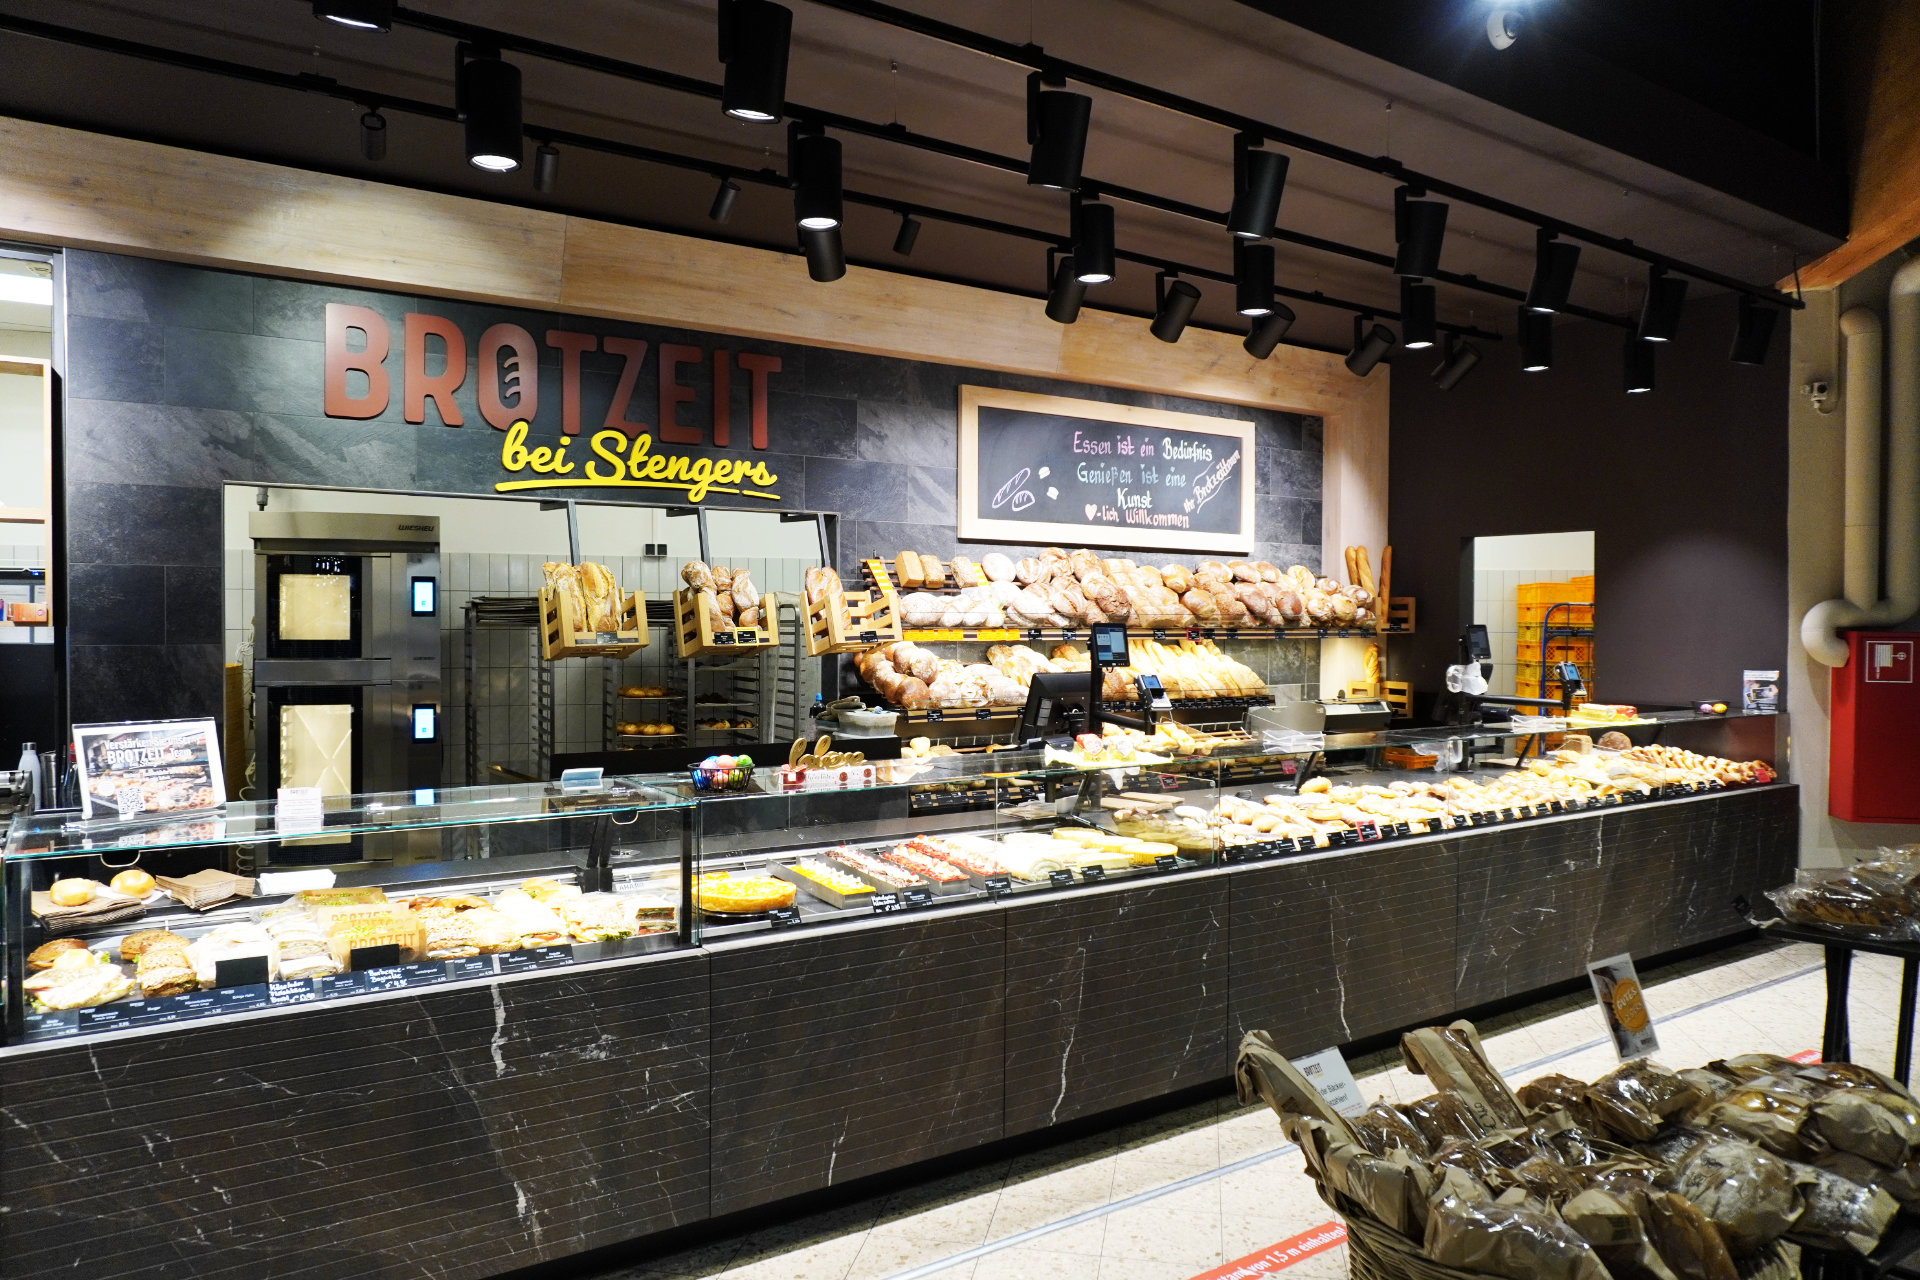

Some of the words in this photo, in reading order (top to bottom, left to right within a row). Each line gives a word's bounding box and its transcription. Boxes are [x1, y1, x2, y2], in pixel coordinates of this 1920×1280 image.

[324, 302, 782, 450] BROTZEIT
[1073, 431, 1111, 455] Essen
[1116, 435, 1135, 456] ist
[1140, 437, 1154, 457] ein
[1162, 437, 1213, 462] Bedürfnis
[501, 421, 575, 474] bei
[585, 430, 778, 503] Stengers
[1077, 462, 1132, 487] Genießen
[1141, 463, 1159, 483] ist
[1165, 466, 1187, 487] eine
[1117, 488, 1152, 510] Kunst
[1126, 509, 1189, 529] Willkommen
[107, 748, 165, 765] BROTZEIT
[1616, 988, 1638, 1010] GUTES
[1248, 1260, 1271, 1274] von
[1265, 1251, 1289, 1264] 1,5
[1286, 1247, 1302, 1257] m
[1297, 1226, 1347, 1252] einhalten!
